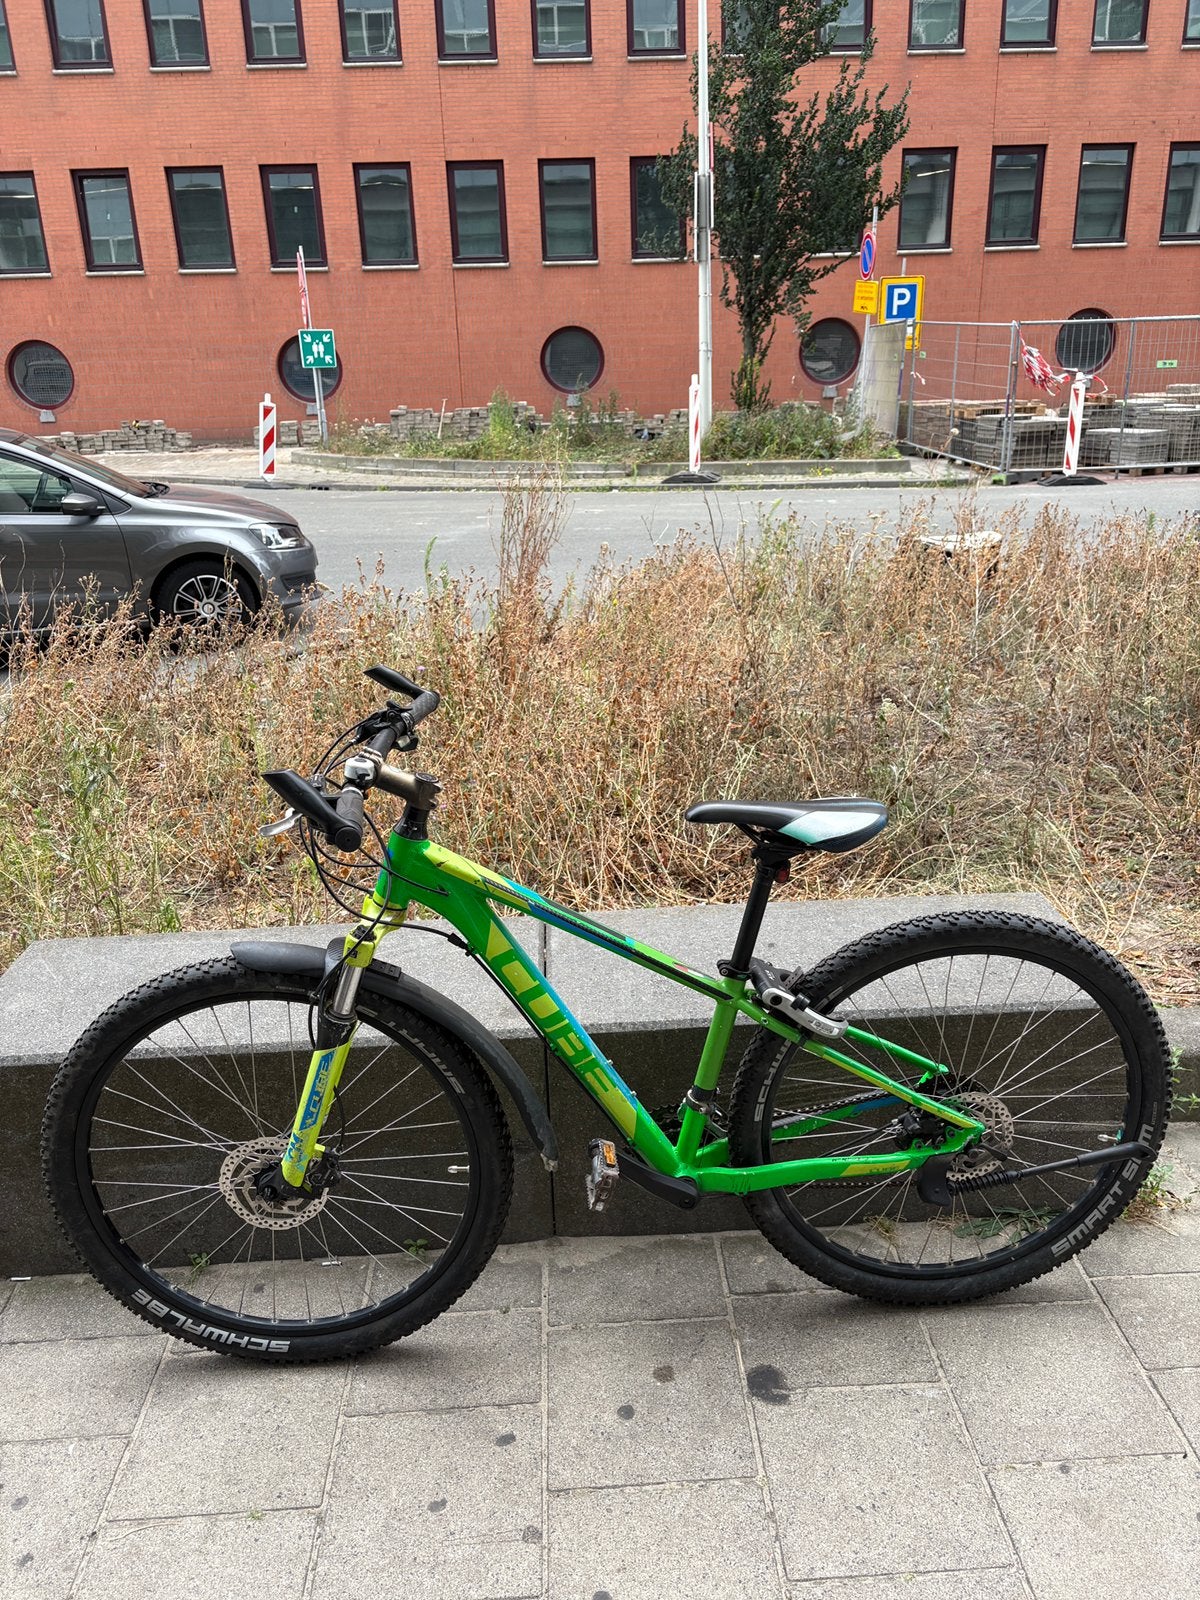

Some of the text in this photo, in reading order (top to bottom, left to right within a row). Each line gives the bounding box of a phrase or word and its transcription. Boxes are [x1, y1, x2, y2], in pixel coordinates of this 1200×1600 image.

[892, 288, 911, 316] P
[488, 948, 618, 1097] CUBE
[1050, 1123, 1155, 1258] SMART SM
[130, 1288, 291, 1353] SCHWALBE
